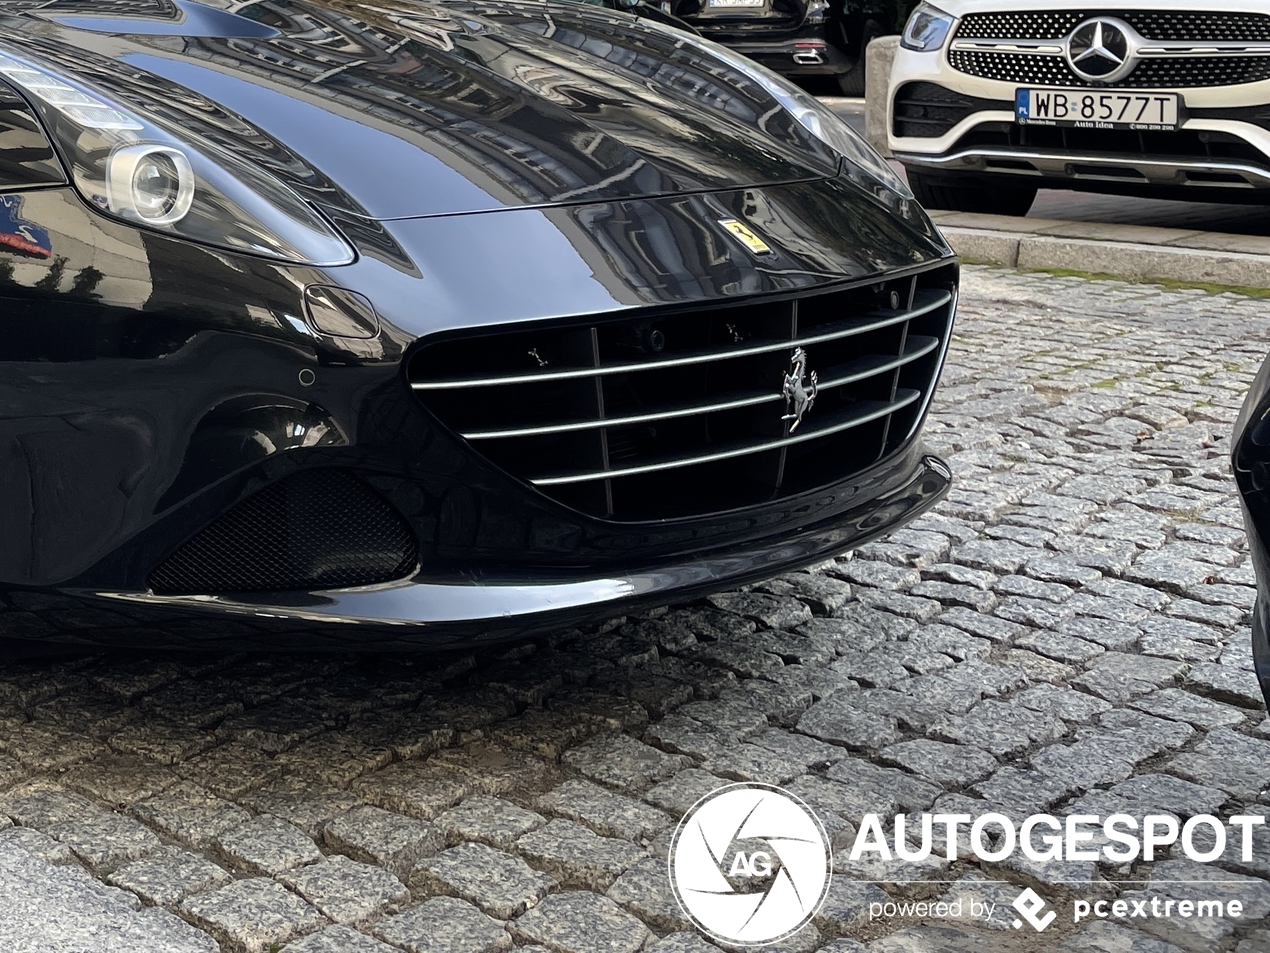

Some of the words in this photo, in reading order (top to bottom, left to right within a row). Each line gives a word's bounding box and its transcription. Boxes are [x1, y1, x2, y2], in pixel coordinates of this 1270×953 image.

[1018, 106, 1028, 115] PL
[1035, 93, 1069, 118] WB
[1080, 95, 1171, 123] 8577T
[1095, 121, 1114, 129] Idea
